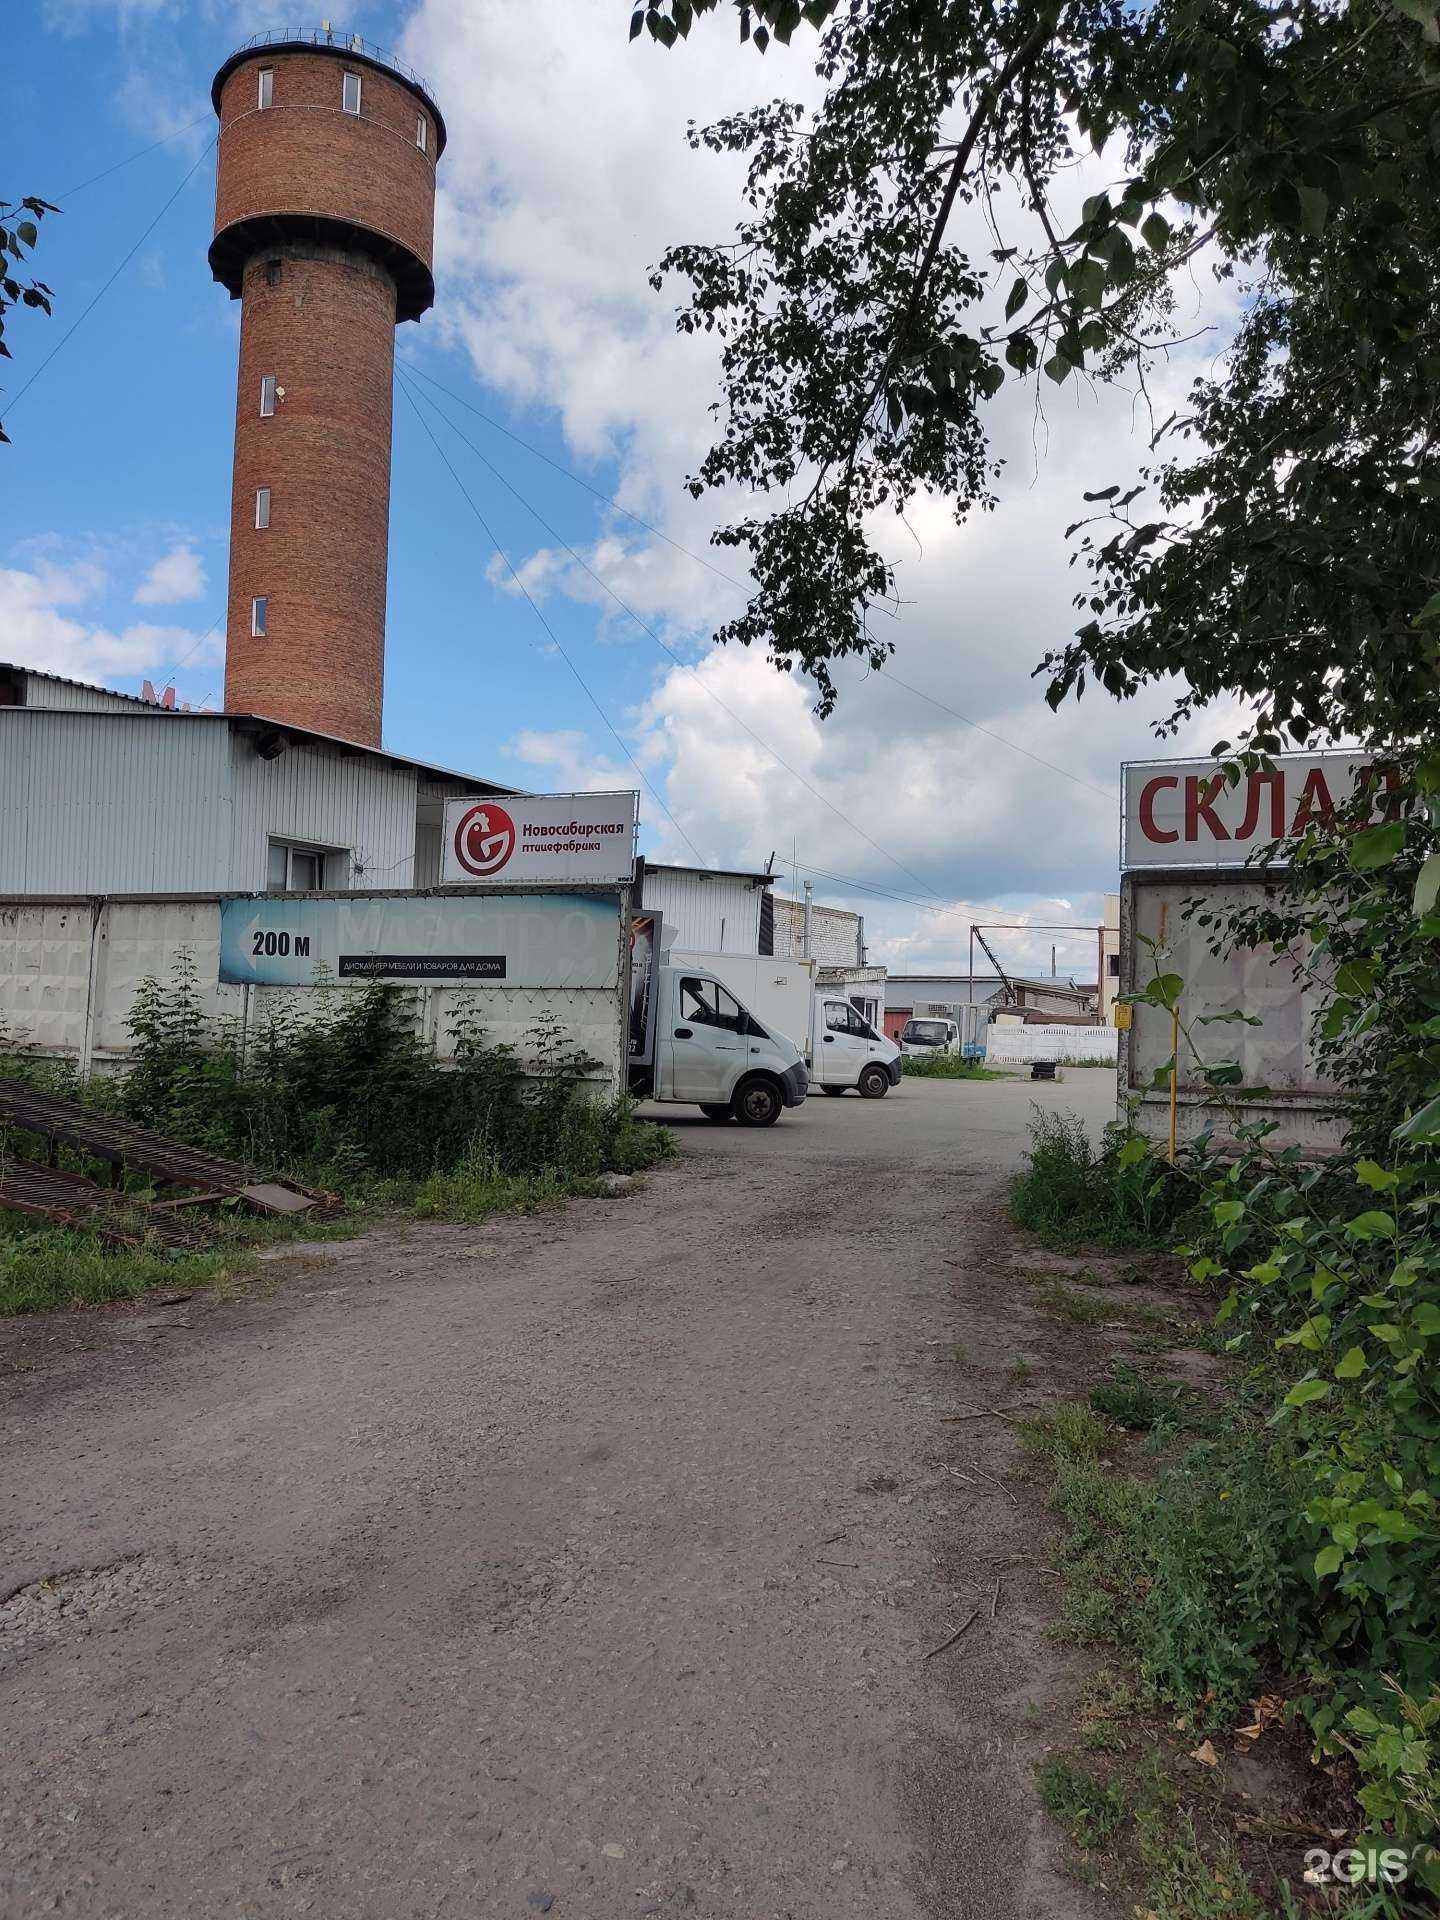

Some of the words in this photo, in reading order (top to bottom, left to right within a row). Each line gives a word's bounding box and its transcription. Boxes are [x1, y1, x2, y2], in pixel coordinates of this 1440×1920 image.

[522, 821, 624, 837] Новосибирская
[522, 840, 601, 853] птицефабрика
[252, 931, 290, 956] 200
[388, 962, 416, 970] МЕБЕЛИ
[423, 962, 458, 970] ТОВАРОВ
[459, 963, 475, 971] ДЛЯ
[476, 962, 501, 971] ДОМА
